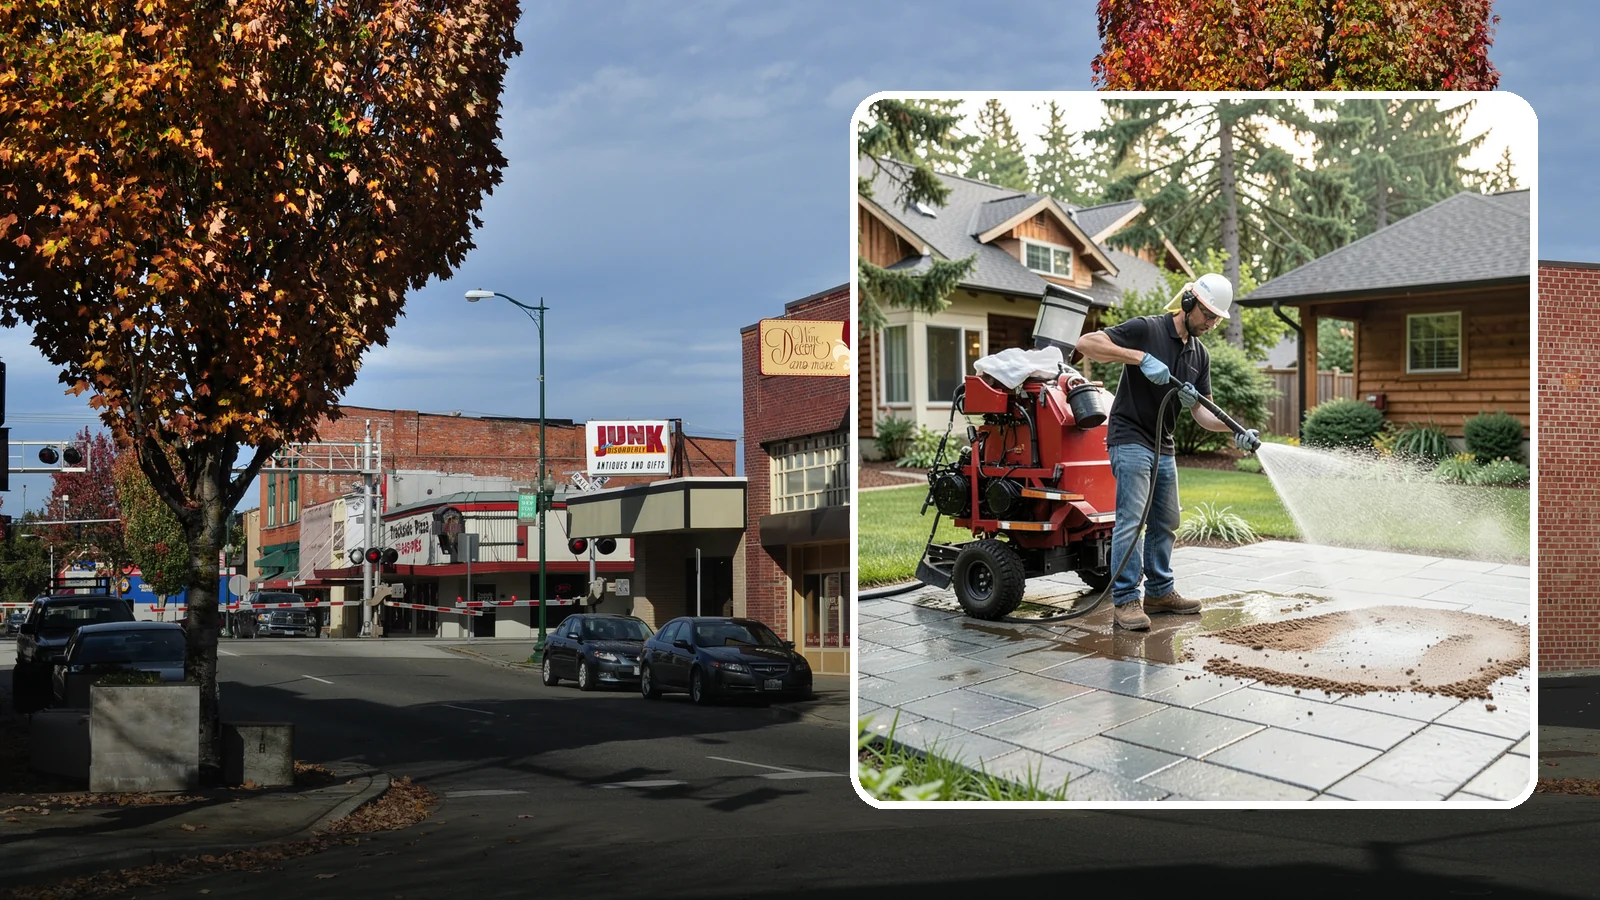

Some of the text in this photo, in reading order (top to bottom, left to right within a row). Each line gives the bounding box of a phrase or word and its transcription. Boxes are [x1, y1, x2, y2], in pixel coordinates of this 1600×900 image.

[596, 425, 664, 457] JUNK
[607, 446, 646, 454] DISORDERLY
[597, 461, 665, 470] ANTIQUES AND GIFTS
